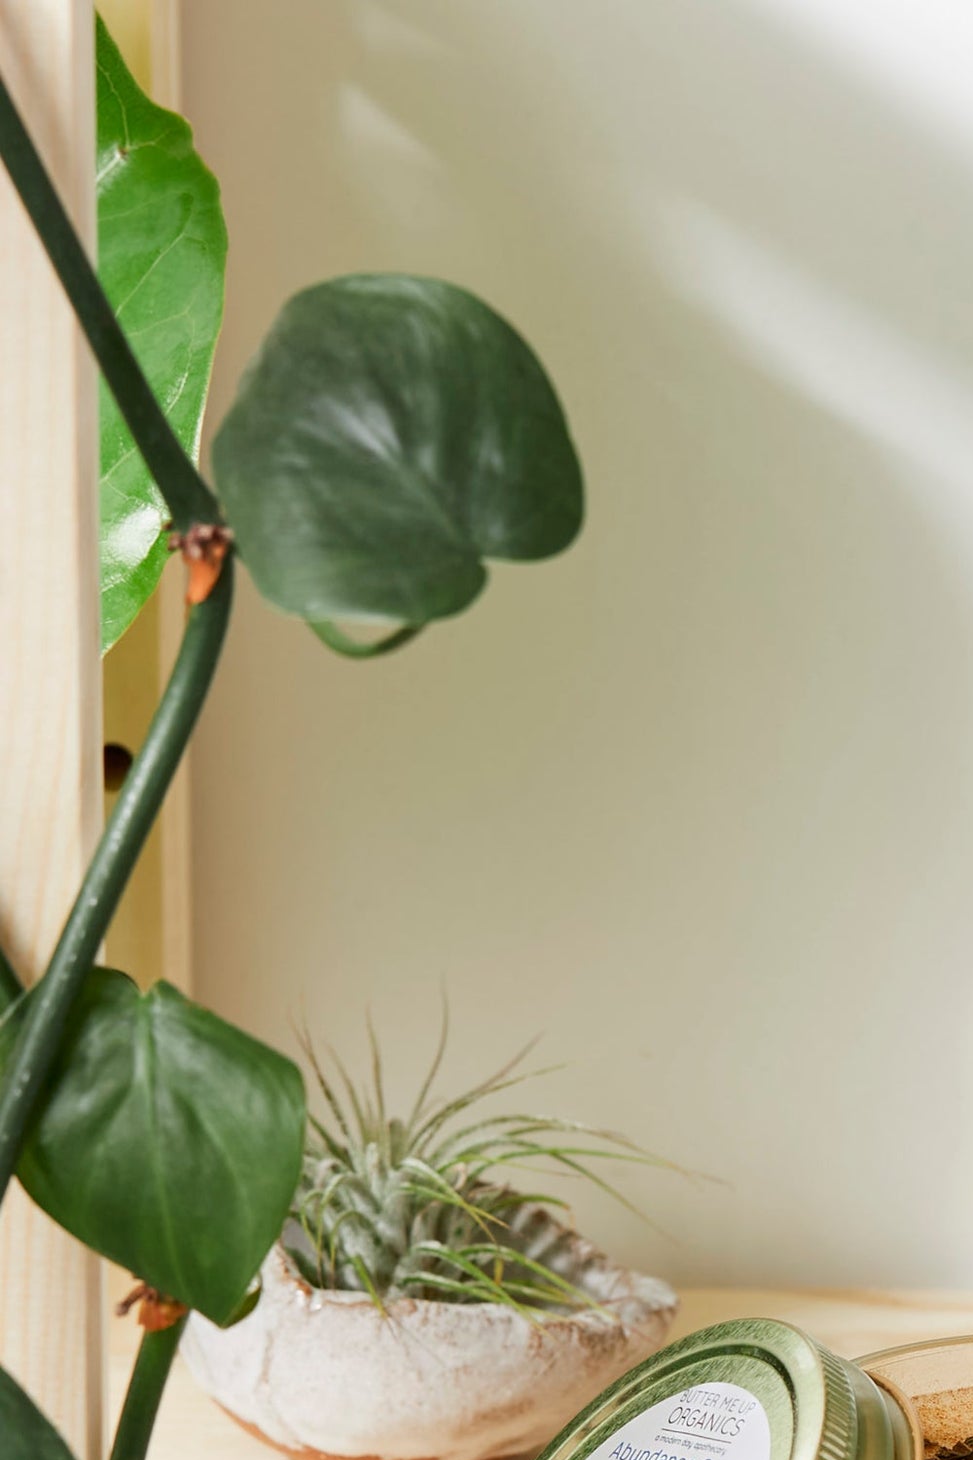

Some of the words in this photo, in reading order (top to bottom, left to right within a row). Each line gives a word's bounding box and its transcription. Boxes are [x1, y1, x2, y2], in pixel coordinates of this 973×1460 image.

[680, 1389, 720, 1407] BUTTER
[719, 1397, 739, 1413] ME
[738, 1401, 757, 1416] UP
[668, 1407, 745, 1437] ORGANICS
